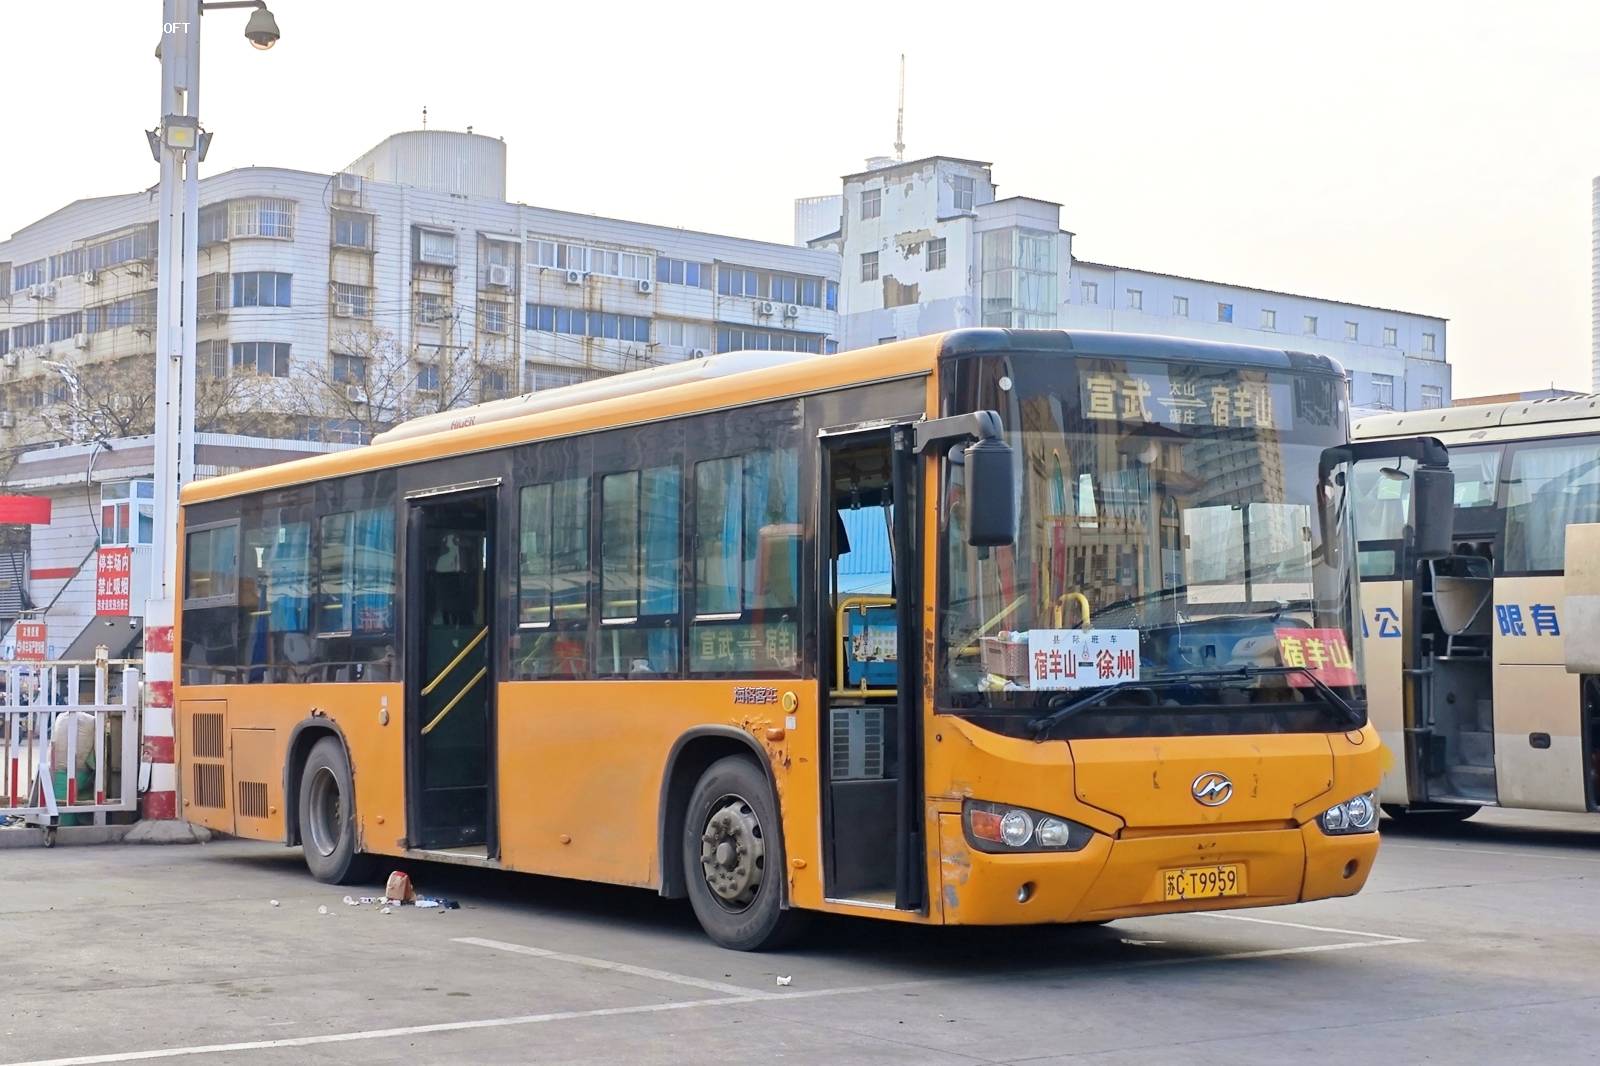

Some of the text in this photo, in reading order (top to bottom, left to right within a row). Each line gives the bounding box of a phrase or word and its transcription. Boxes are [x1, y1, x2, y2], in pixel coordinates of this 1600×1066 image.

[1087, 375, 1273, 429] 宣武 宿羊山
[98, 553, 129, 573] 停车场内
[97, 576, 129, 596] 禁止吸烟
[1279, 636, 1353, 670] 宿羊山
